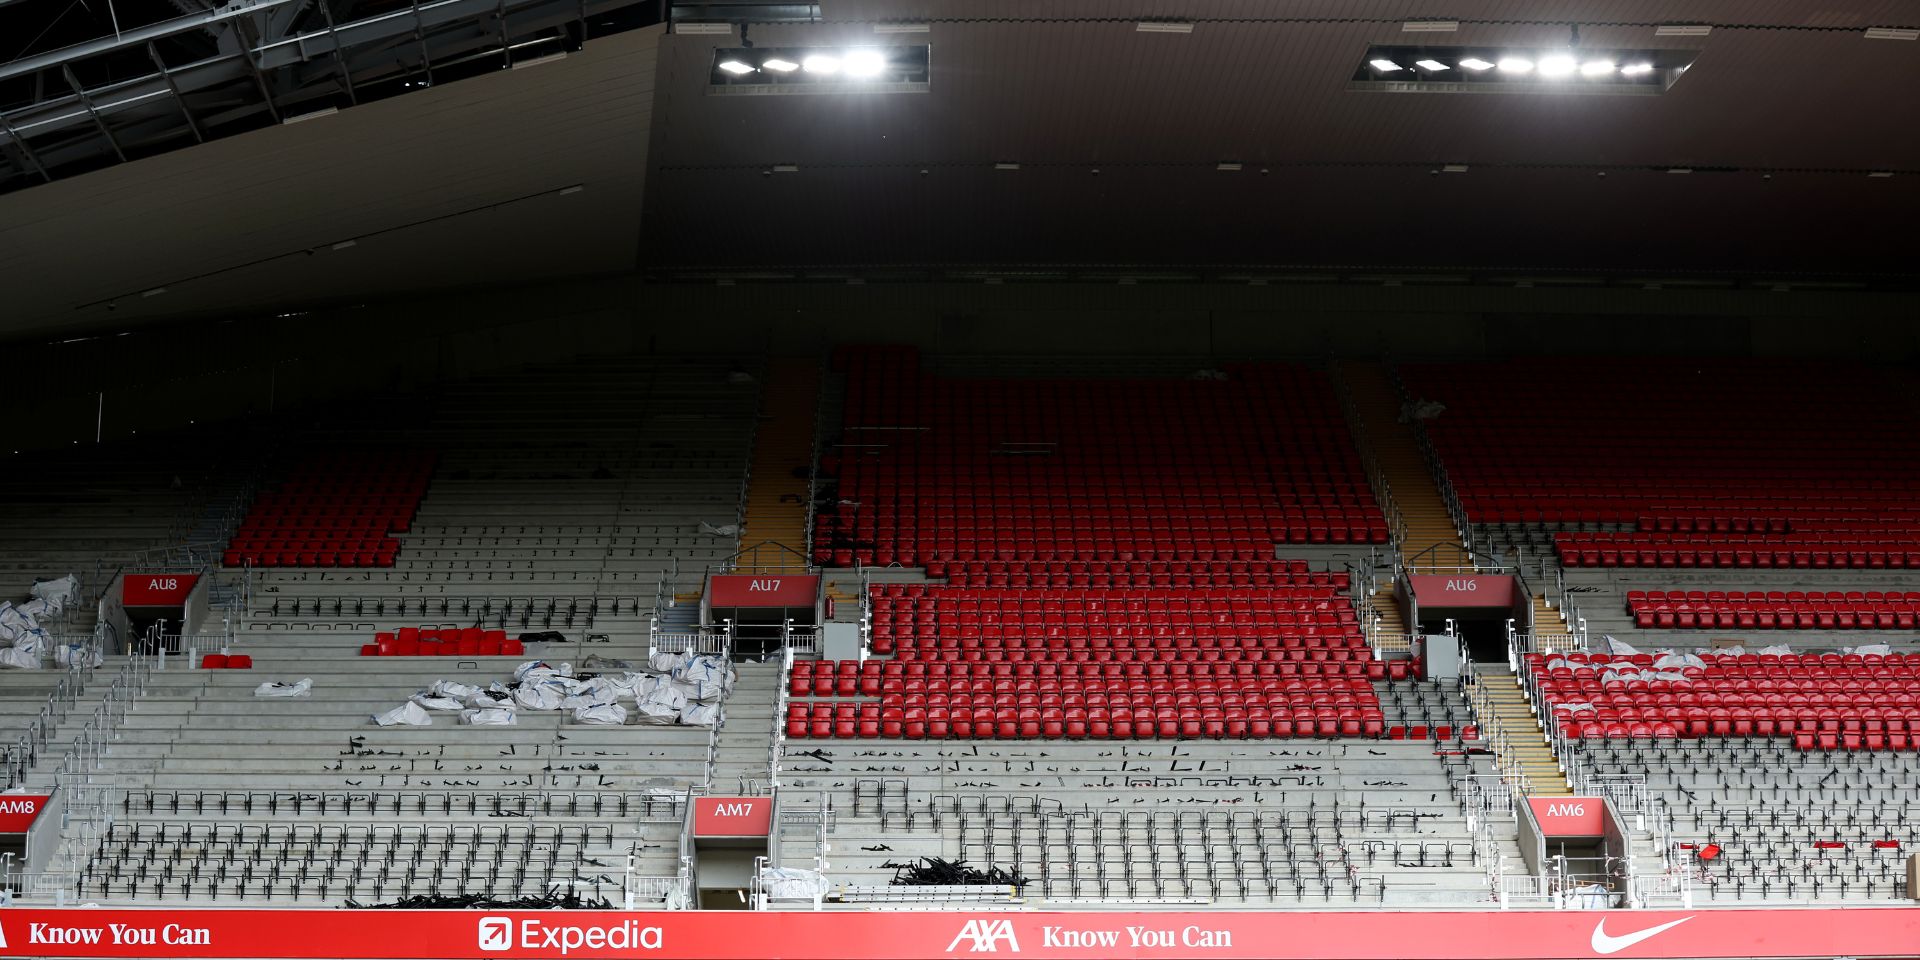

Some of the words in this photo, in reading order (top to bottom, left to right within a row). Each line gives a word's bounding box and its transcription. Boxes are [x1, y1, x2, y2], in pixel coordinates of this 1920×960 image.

[148, 578, 178, 591] AU8
[749, 579, 781, 592] AU7
[1445, 579, 1477, 591] AU6
[0, 800, 35, 814] AM8
[714, 803, 753, 817] AM7
[1546, 803, 1585, 817] AM6
[29, 923, 103, 945] Know
[108, 923, 157, 945] You
[162, 923, 211, 945] Can
[521, 919, 663, 955] Expedia
[945, 919, 1020, 952] AXA
[1042, 926, 1120, 947] Know
[1125, 926, 1176, 947] You
[1181, 925, 1232, 947] Can
